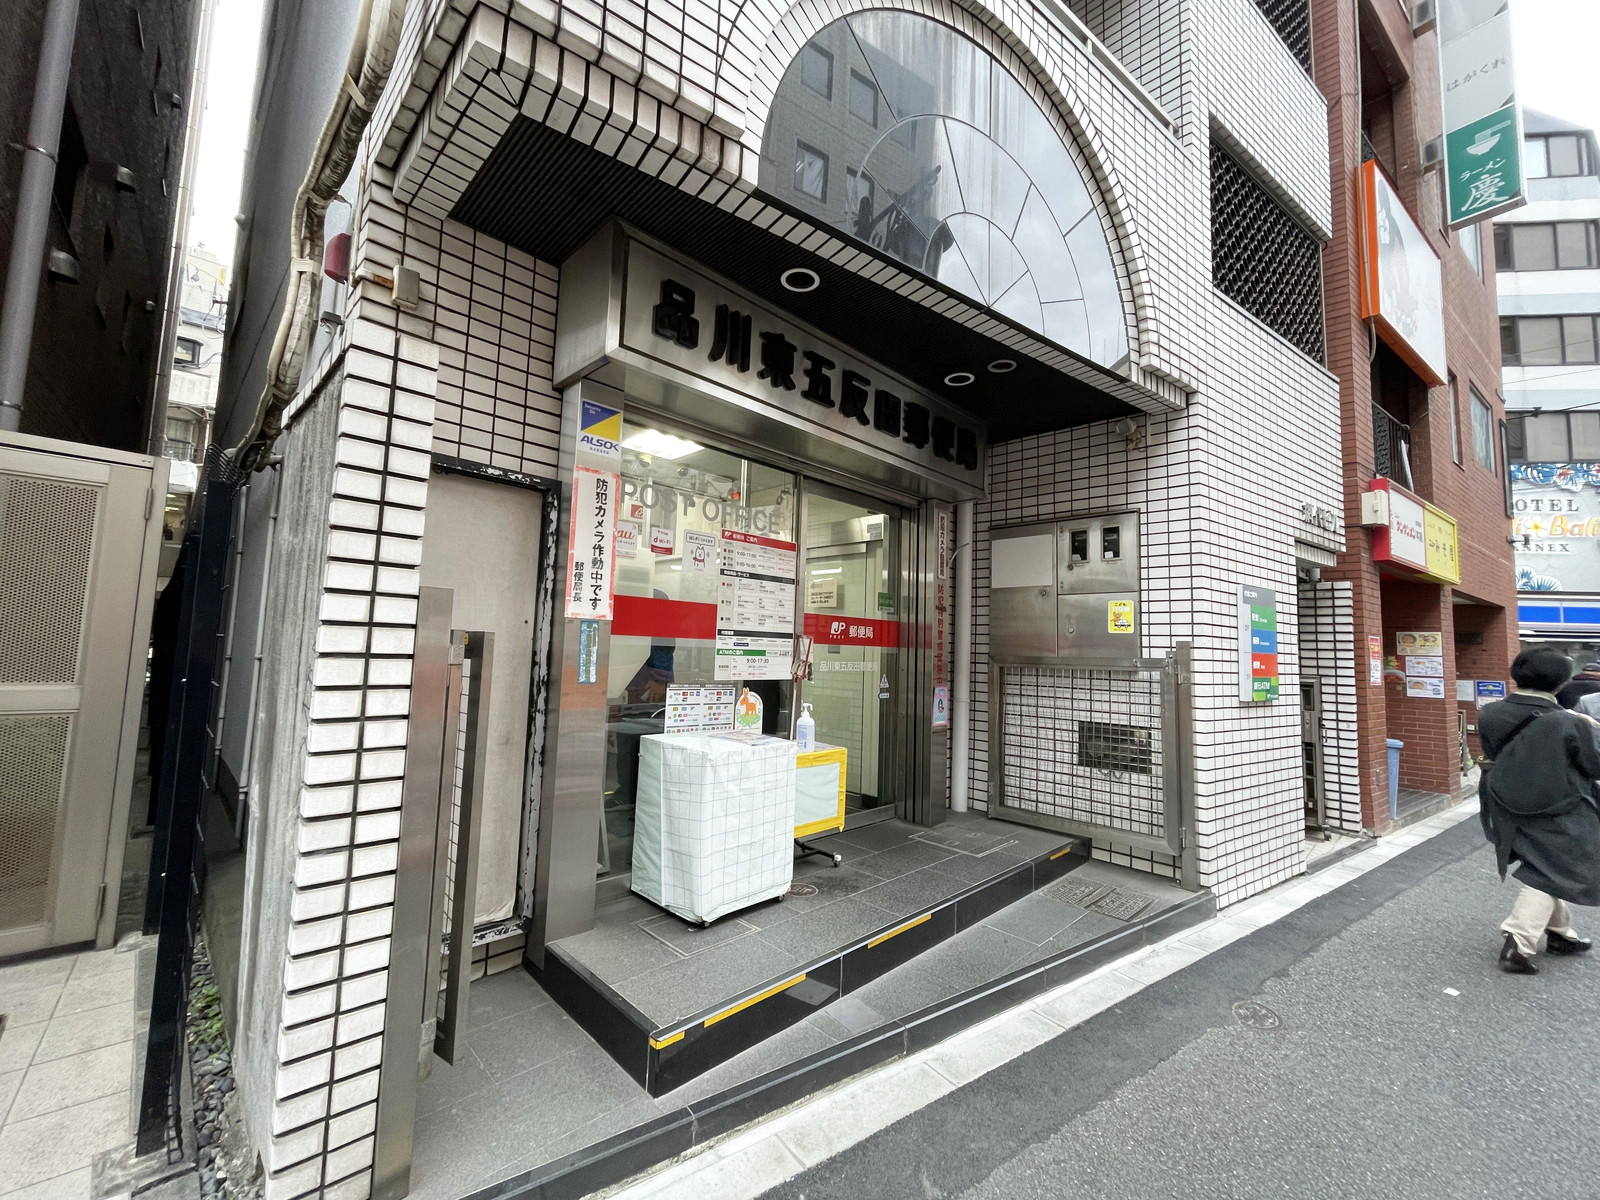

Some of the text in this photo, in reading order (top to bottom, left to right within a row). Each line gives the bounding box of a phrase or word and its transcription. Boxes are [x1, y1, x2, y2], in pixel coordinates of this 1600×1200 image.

[1446, 57, 1506, 92] はがくれ
[1460, 157, 1506, 183] ラーメン
[1461, 171, 1509, 212] 慶
[580, 435, 620, 452] ALSOK
[621, 479, 781, 536] POST OFFICE
[1513, 498, 1580, 512] OTEL
[589, 478, 608, 611] 防犯カメラ作動中です
[616, 530, 636, 540] au
[572, 561, 584, 603] 郵便局長
[848, 625, 874, 639] 郵便局
